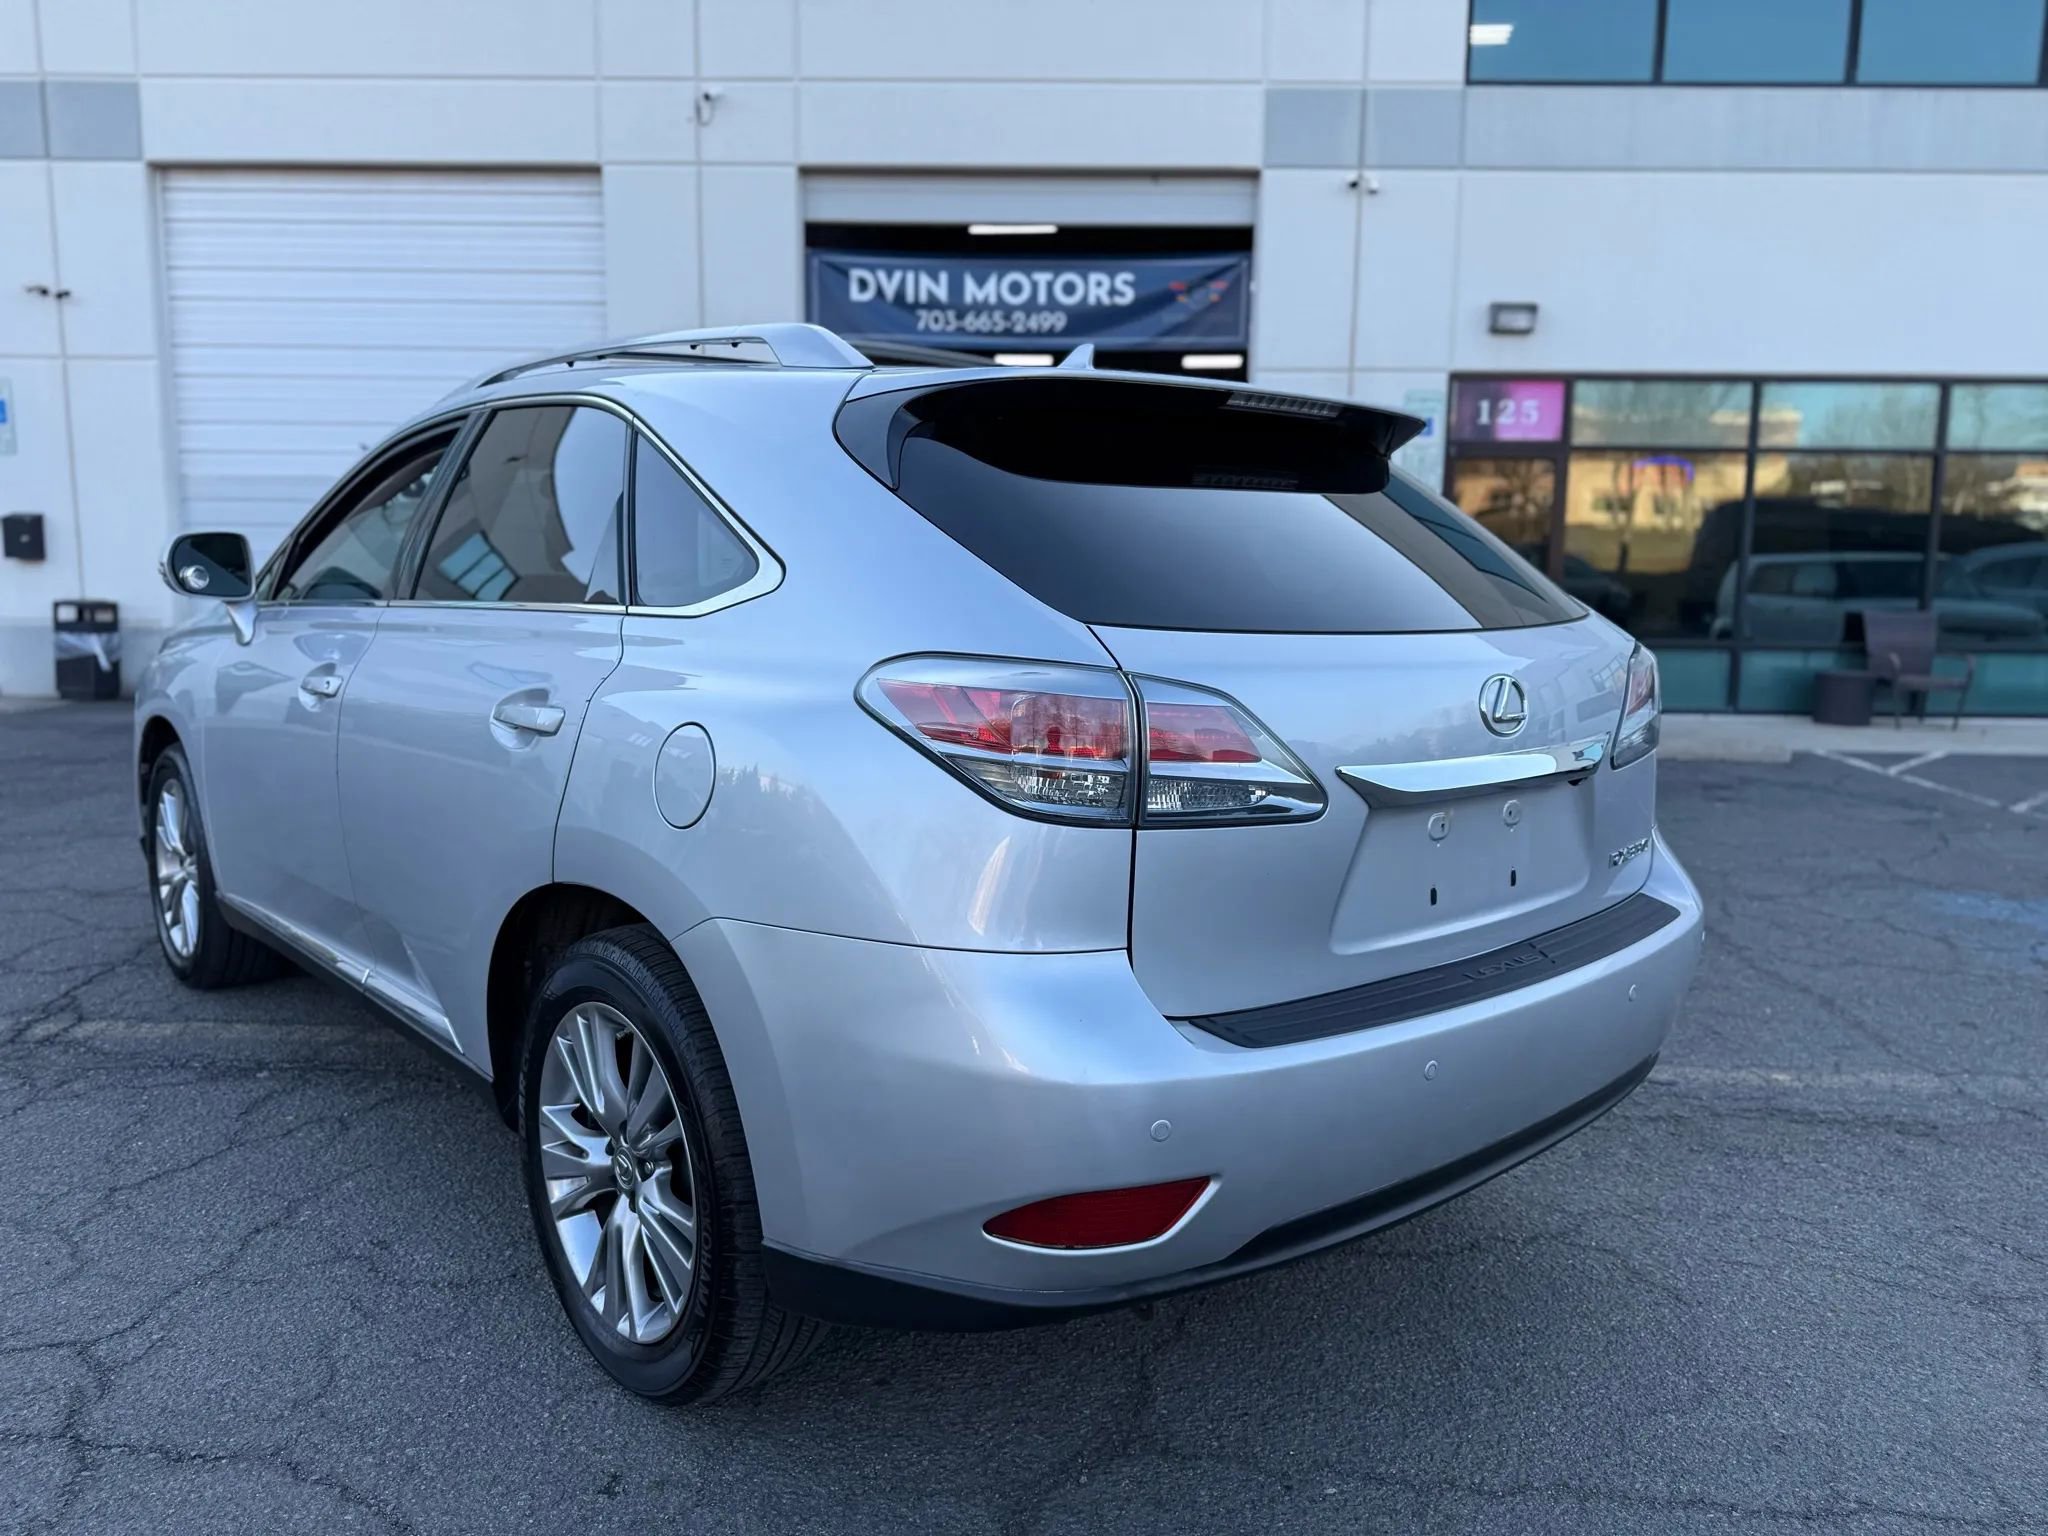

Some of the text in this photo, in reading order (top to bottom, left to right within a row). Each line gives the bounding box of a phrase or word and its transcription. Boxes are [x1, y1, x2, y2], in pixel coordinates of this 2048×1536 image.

[848, 268, 1136, 306] DVIN MOTORS
[914, 309, 1068, 333] 703-665-2499
[1476, 399, 1540, 426] 125
